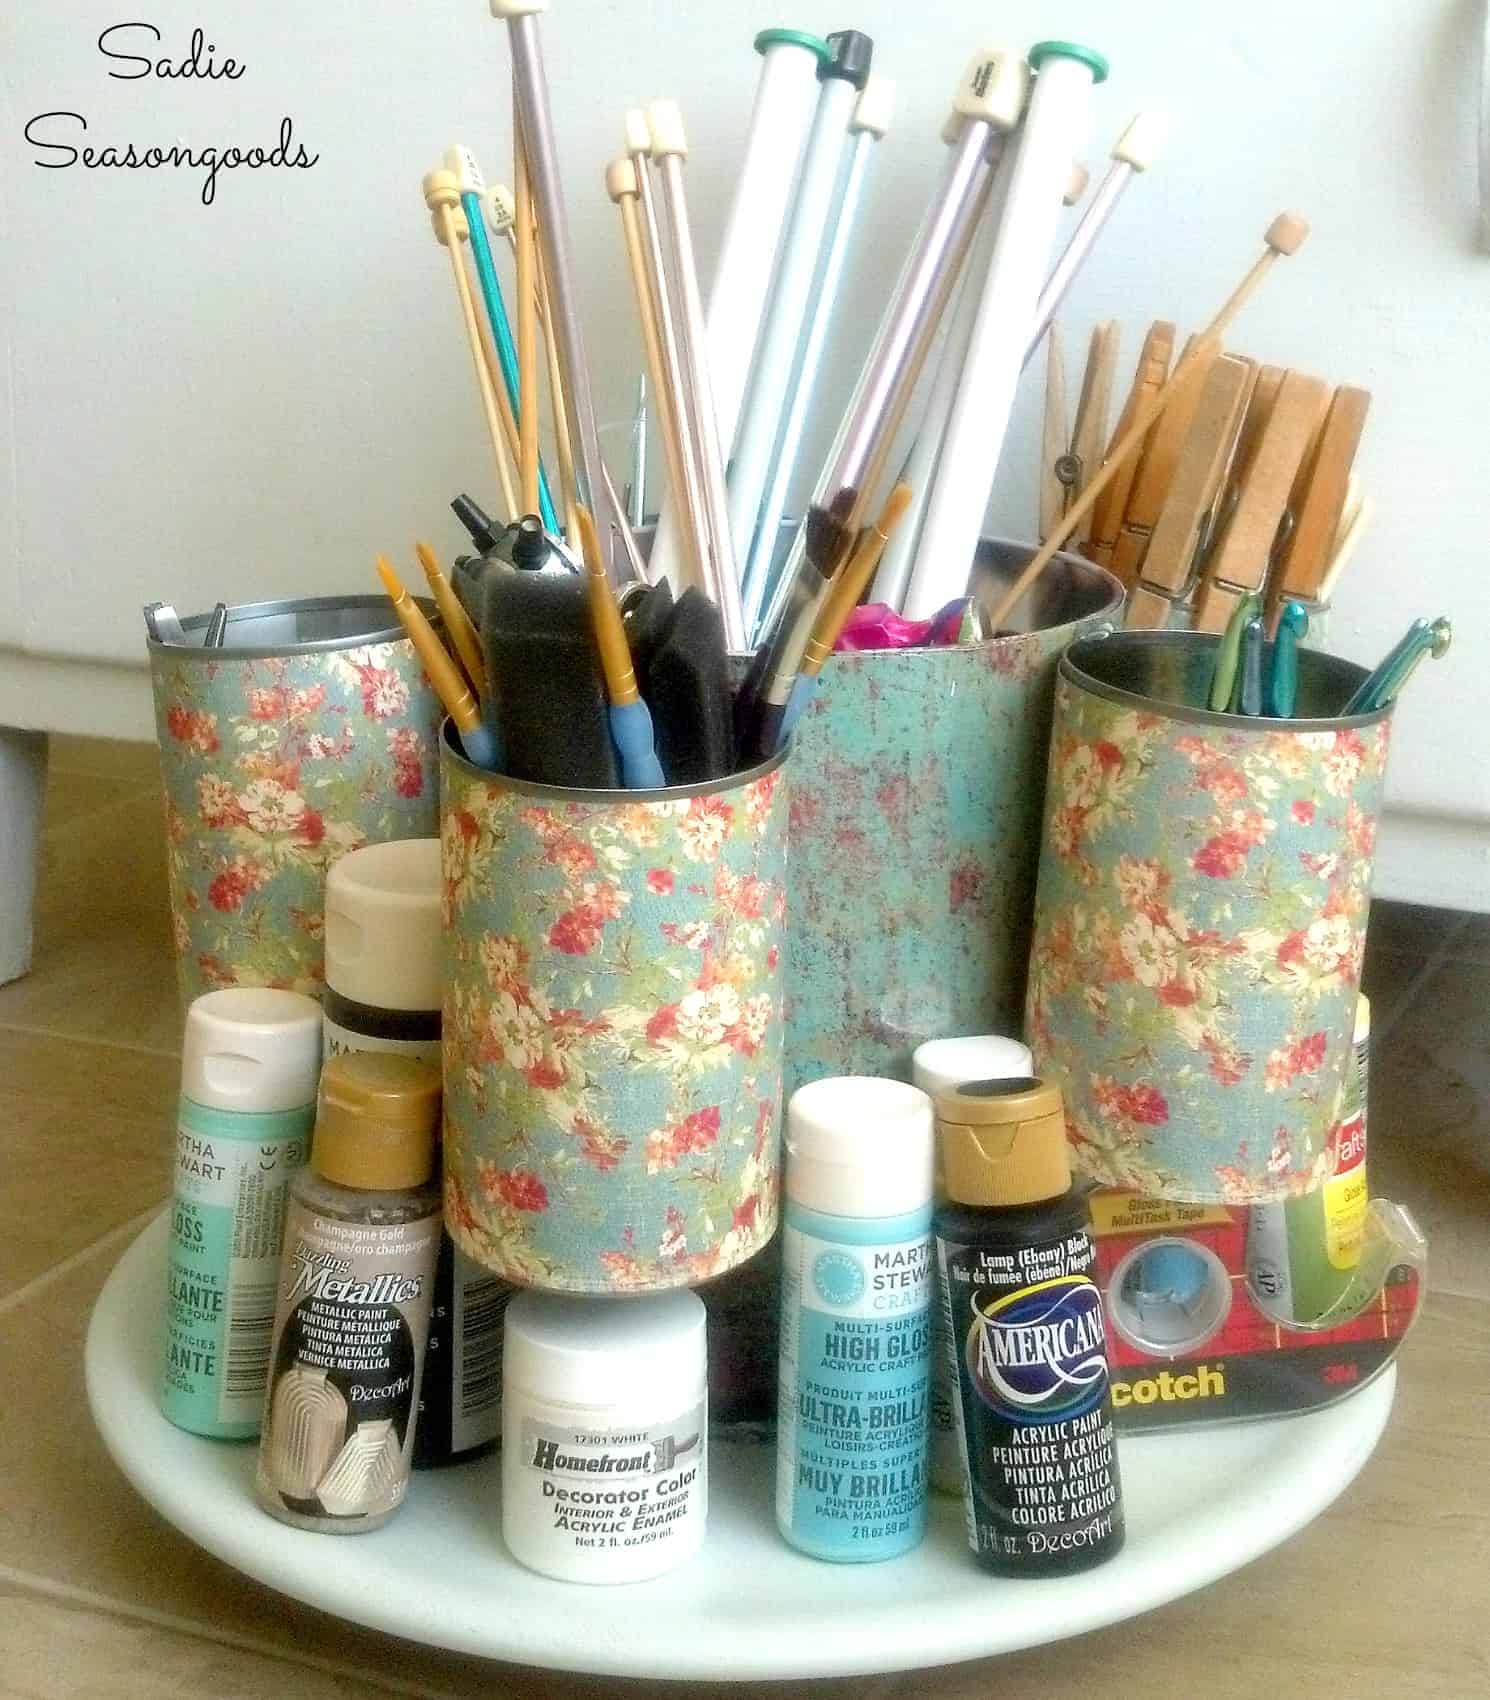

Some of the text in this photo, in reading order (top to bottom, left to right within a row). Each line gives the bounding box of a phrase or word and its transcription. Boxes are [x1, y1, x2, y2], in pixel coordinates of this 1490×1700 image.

[1111, 1207, 1205, 1227] MultiTask Tape
[379, 1224, 405, 1241] Gold
[980, 1251, 1015, 1273] Lamp
[1017, 1241, 1066, 1268] (Ebony)
[1067, 1231, 1090, 1256] Black
[285, 1257, 424, 1305] Metallics
[972, 1267, 986, 1285] de
[297, 1308, 341, 1331] PEINTURE
[311, 1301, 389, 1321] METALLIC PAINT
[302, 1323, 342, 1344] PINTURA
[307, 1338, 334, 1355] TINTA
[825, 1333, 880, 1361] HIGH
[298, 1349, 390, 1370] VERNICE METALLICA
[820, 1357, 877, 1374] ACRYLIC
[350, 1376, 411, 1402] DecoArt
[806, 1380, 864, 1401] PRODUIT
[1110, 1366, 1225, 1407] cotch
[803, 1419, 862, 1442] PEINTURE
[1011, 1408, 1102, 1446] ACRYLIC PAINT
[611, 1431, 649, 1445] WHITE
[824, 1439, 876, 1453] LOISIRS
[992, 1420, 1114, 1466] PEINTURE ACRYLIQUE
[532, 1438, 652, 1474] Homefront
[801, 1450, 878, 1471] MULTIPLES
[799, 1464, 843, 1497] MUY
[1004, 1463, 1065, 1485] PINTURA
[542, 1467, 697, 1505] Decorator Color
[1015, 1486, 1057, 1505] TINTA
[553, 1490, 690, 1520] INTERIOR & EXTERIOR
[815, 1503, 849, 1521] PARA
[825, 1496, 881, 1512] PINTURA
[1011, 1485, 1116, 1525] COLORE ACRILICO
[553, 1503, 689, 1534] ACRYLIC ENAMEL
[851, 1526, 860, 1539] 2
[871, 1527, 884, 1539] oz
[885, 1523, 897, 1536] 59
[1026, 1511, 1114, 1554] DecoArt
[574, 1536, 596, 1548] Net
[598, 1537, 606, 1548] 2
